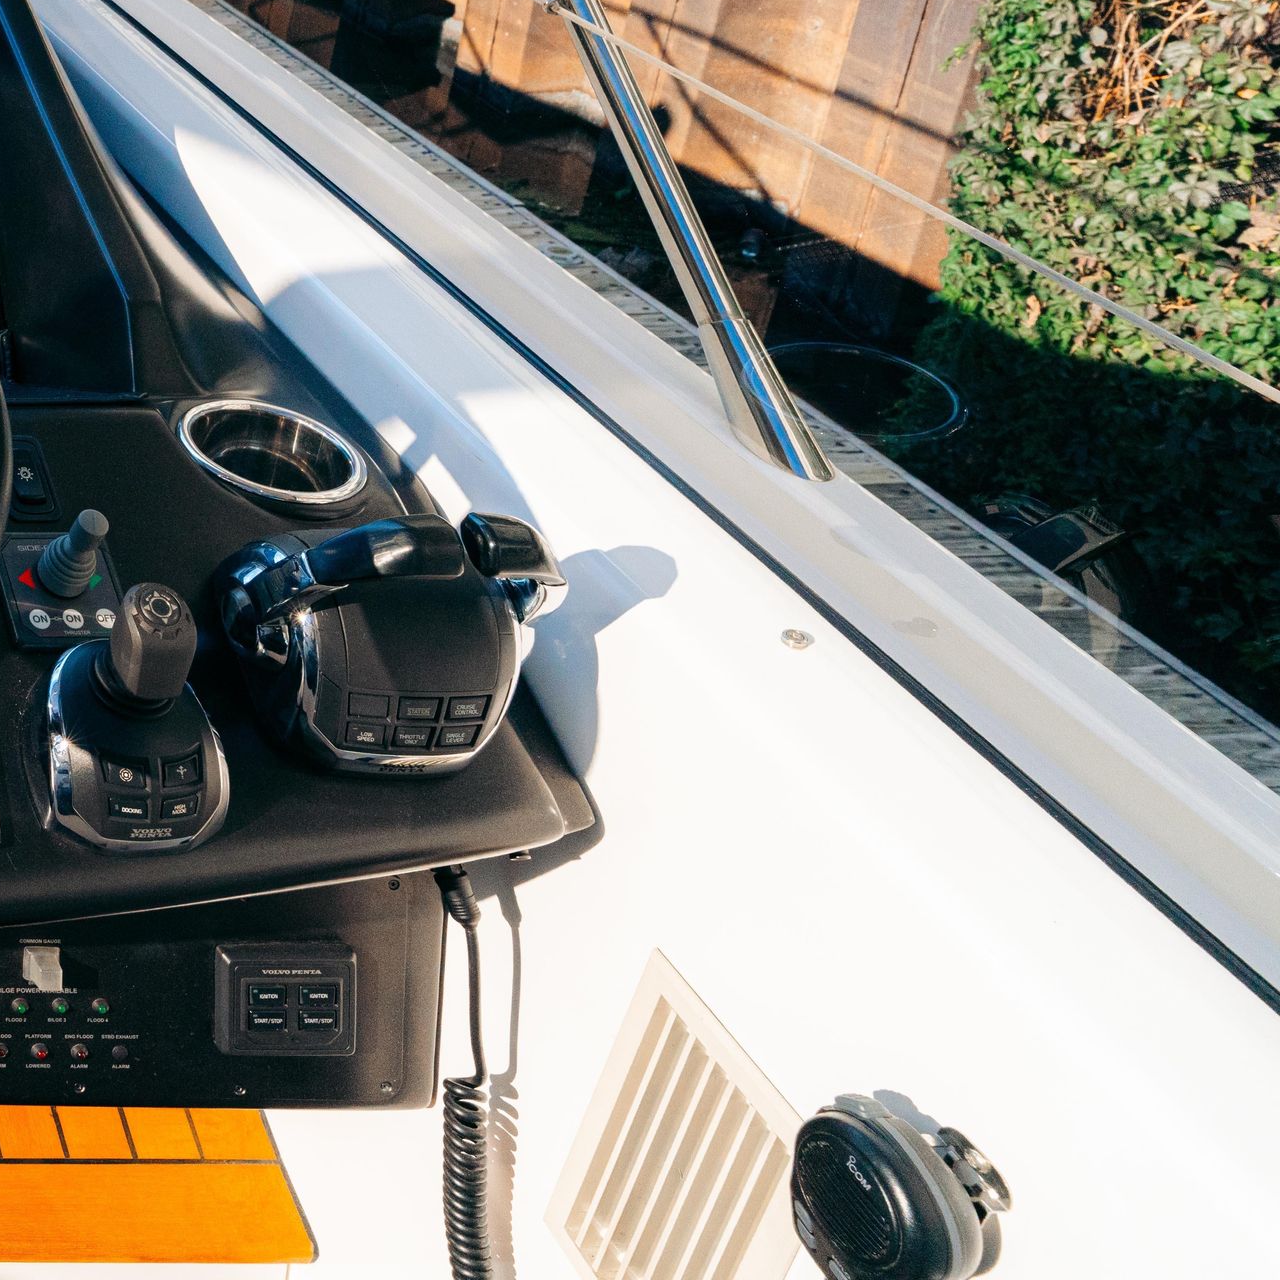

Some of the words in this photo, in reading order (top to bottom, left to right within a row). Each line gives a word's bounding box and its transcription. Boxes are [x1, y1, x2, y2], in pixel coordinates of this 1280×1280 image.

[32, 615, 49, 623] ON
[66, 614, 82, 623] ON
[96, 614, 116, 622] OFF
